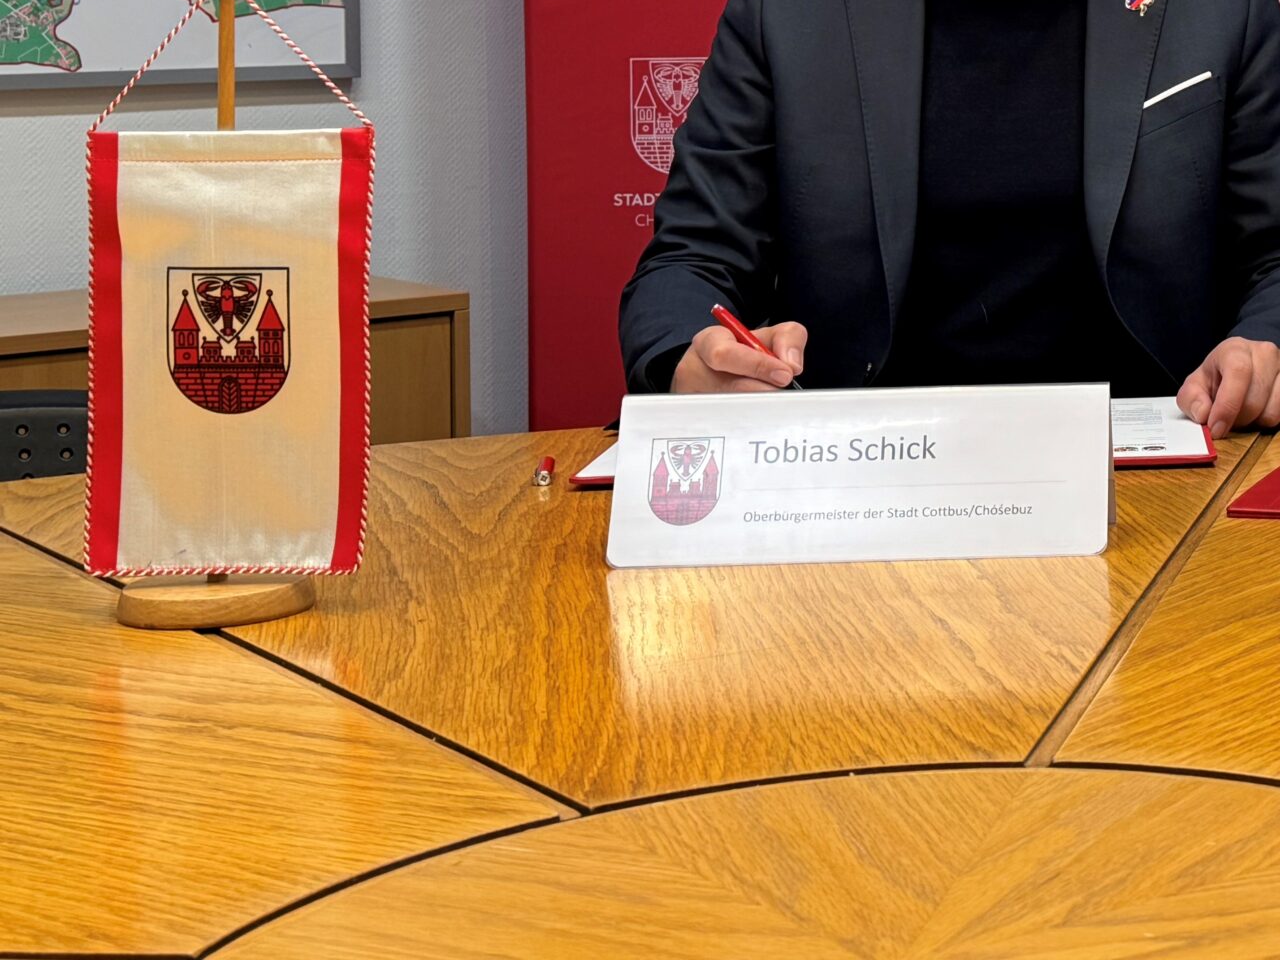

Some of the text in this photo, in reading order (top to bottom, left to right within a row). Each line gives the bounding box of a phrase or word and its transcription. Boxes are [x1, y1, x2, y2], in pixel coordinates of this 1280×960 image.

[613, 193, 661, 207] STAD
[748, 434, 937, 464] Tobias Schick
[743, 503, 1033, 523] Oberbürgermeister der Stadt Cottbus/Chóśebuz
